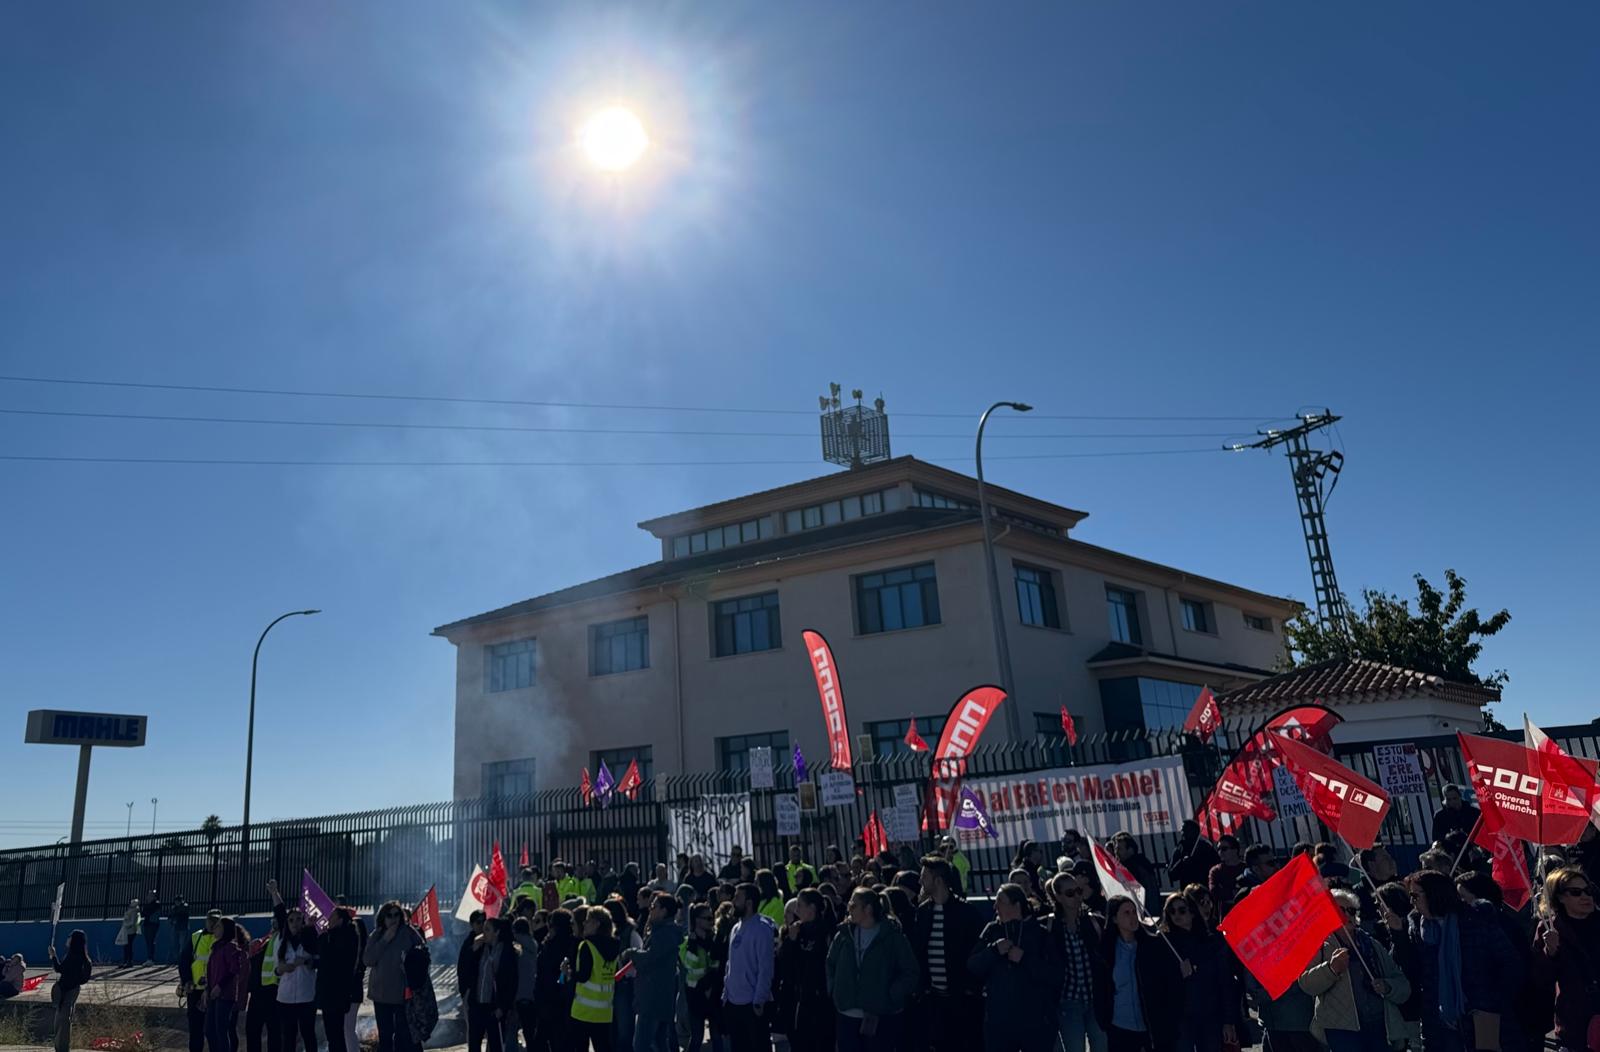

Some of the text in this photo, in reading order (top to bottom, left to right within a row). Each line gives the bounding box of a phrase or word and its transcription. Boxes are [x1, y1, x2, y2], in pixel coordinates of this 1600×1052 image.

[53, 714, 139, 741] MAHLE
[1377, 745, 1402, 756] ESTO
[1378, 755, 1407, 765] ES UN
[1388, 763, 1413, 776] ERE
[1386, 773, 1421, 785] ES UNA
[990, 786, 1010, 812] al
[1013, 779, 1049, 810] ERE
[1052, 782, 1080, 804] en
[1083, 768, 1163, 801] Mahle!
[1494, 792, 1531, 806] Obreras
[1108, 800, 1141, 812] familias
[1501, 801, 1538, 816] Mancha
